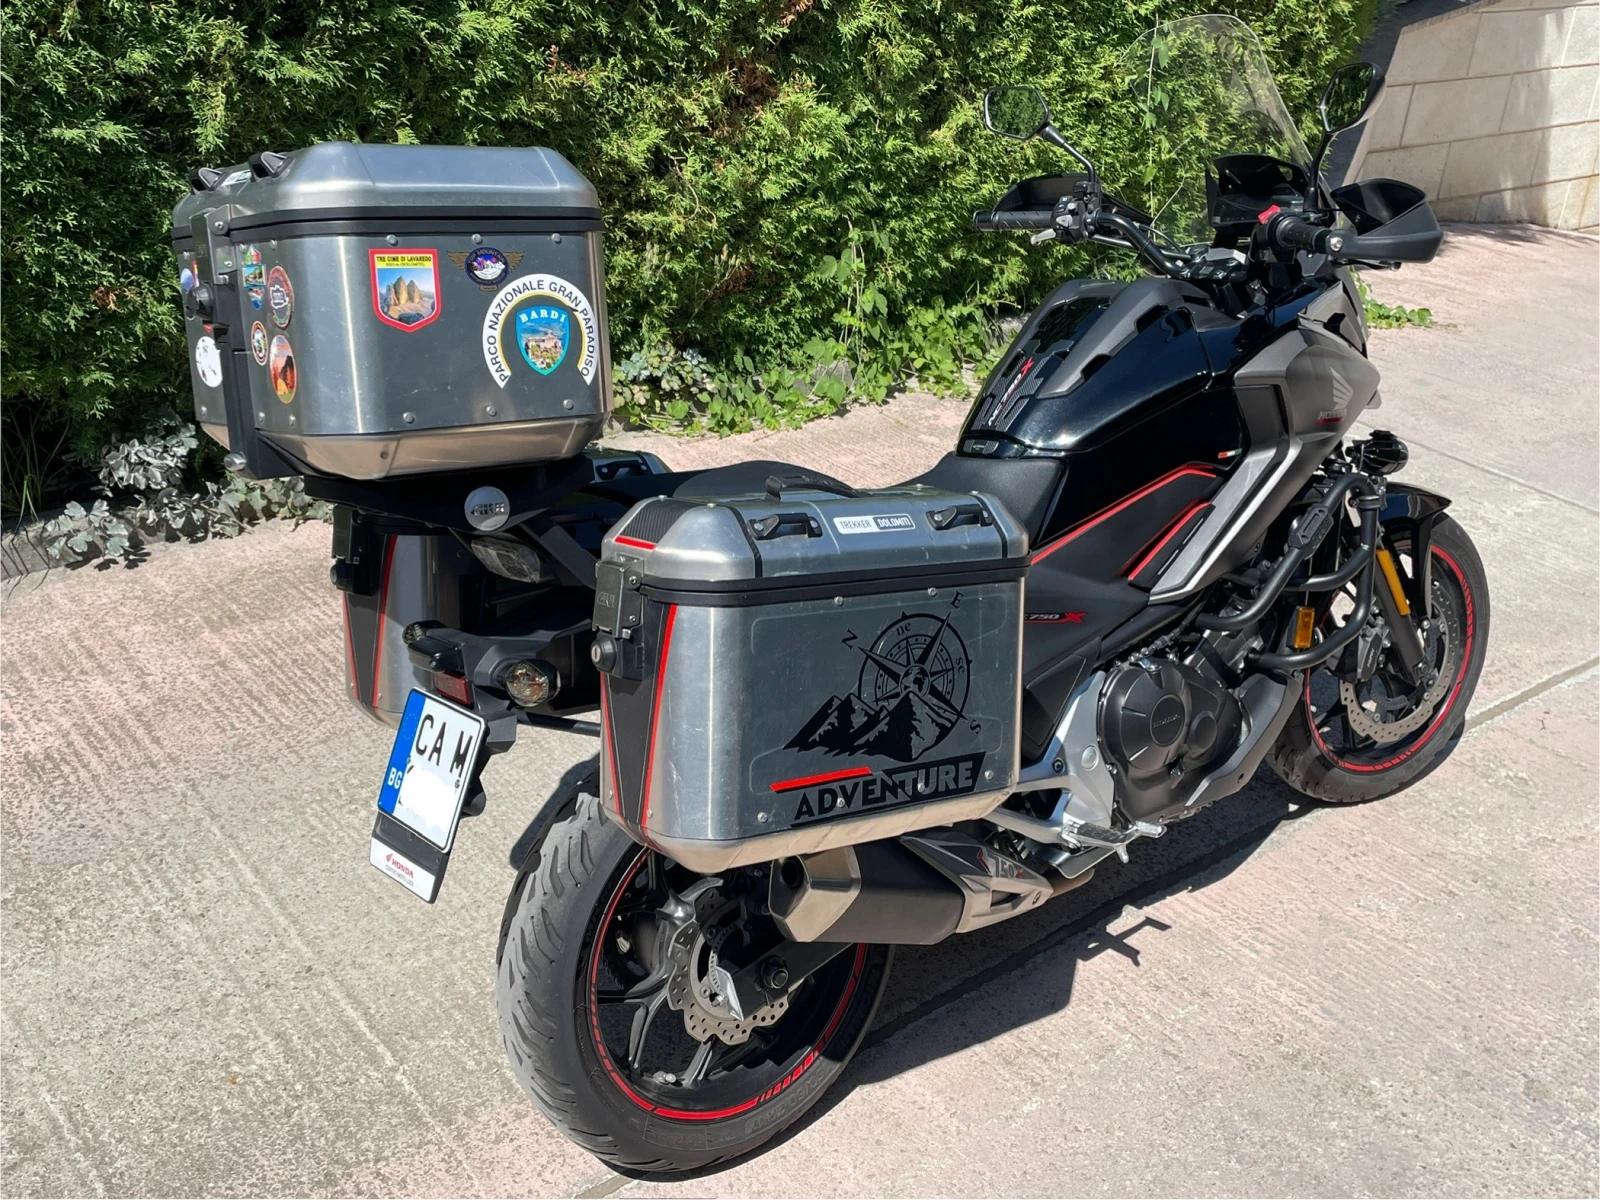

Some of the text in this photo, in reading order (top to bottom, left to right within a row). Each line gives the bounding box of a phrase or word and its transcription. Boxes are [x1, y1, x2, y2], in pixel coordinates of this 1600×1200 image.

[519, 309, 566, 323] BARDI
[487, 280, 595, 382] PARCO NAZIONALE GRAN PARADISO
[839, 517, 911, 530] TREKKER DOLOMITI
[950, 589, 964, 609] E
[896, 622, 911, 636] ne
[969, 719, 982, 735] S
[415, 713, 473, 778] CA M
[387, 766, 403, 790] BG
[793, 760, 973, 821] ADVENTURE
[391, 858, 414, 879] HONDA
